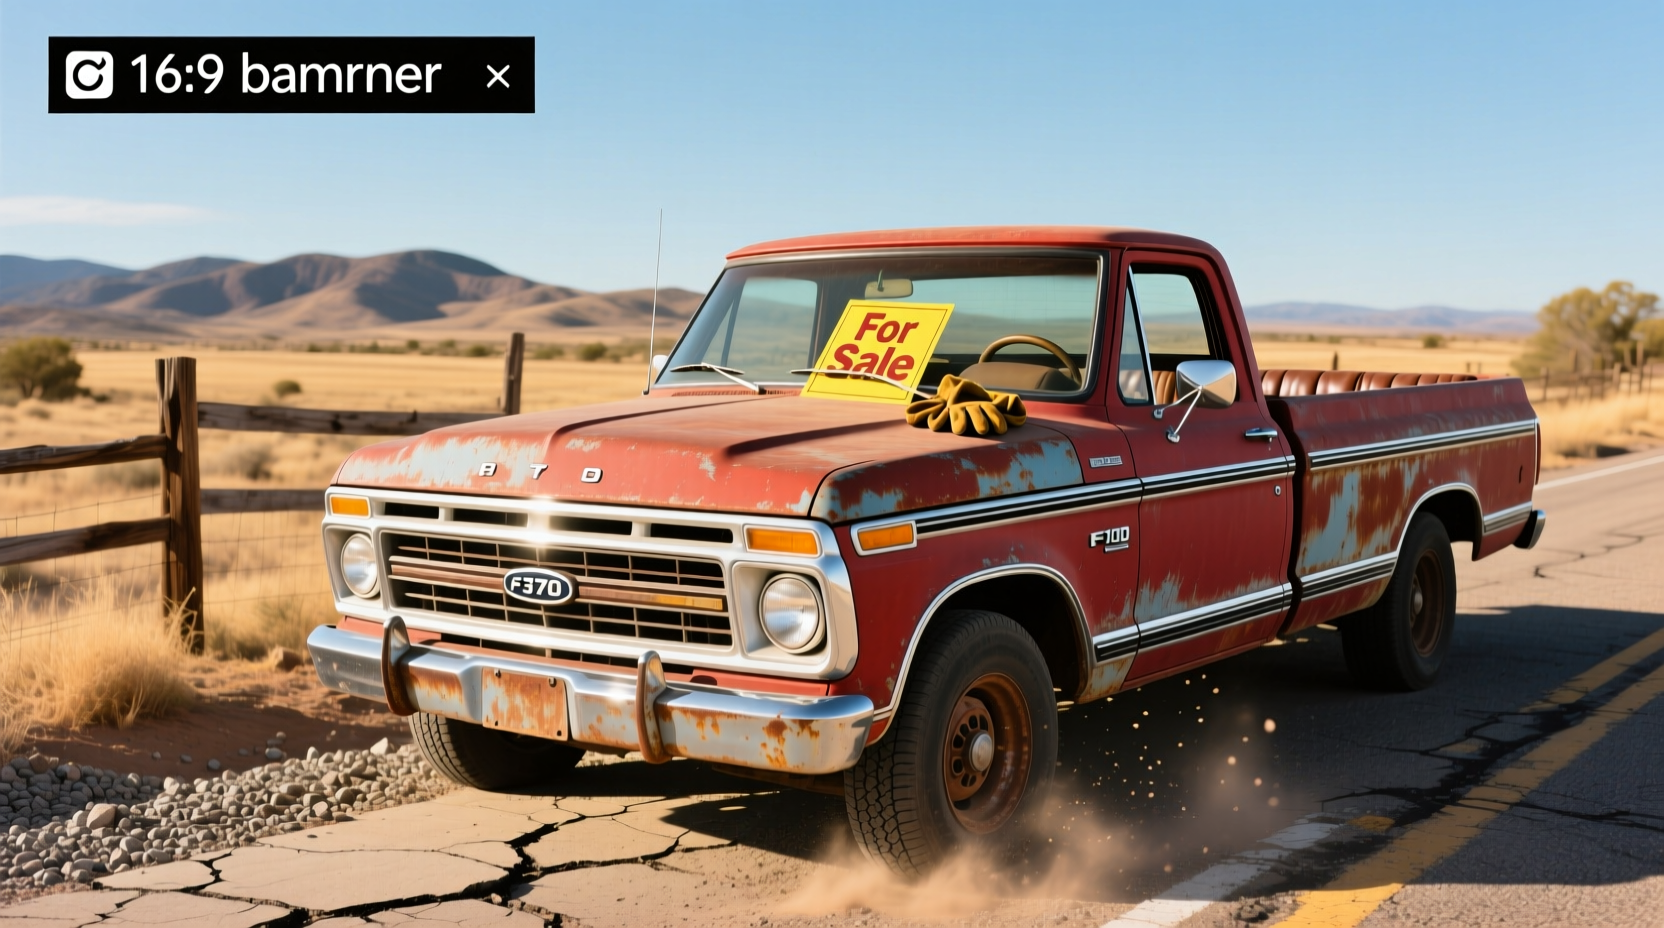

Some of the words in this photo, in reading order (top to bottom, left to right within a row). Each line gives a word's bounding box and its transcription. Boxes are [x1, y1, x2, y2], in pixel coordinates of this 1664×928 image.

[854, 312, 920, 344] For
[826, 343, 915, 381] Sale
[510, 576, 562, 597] F370
